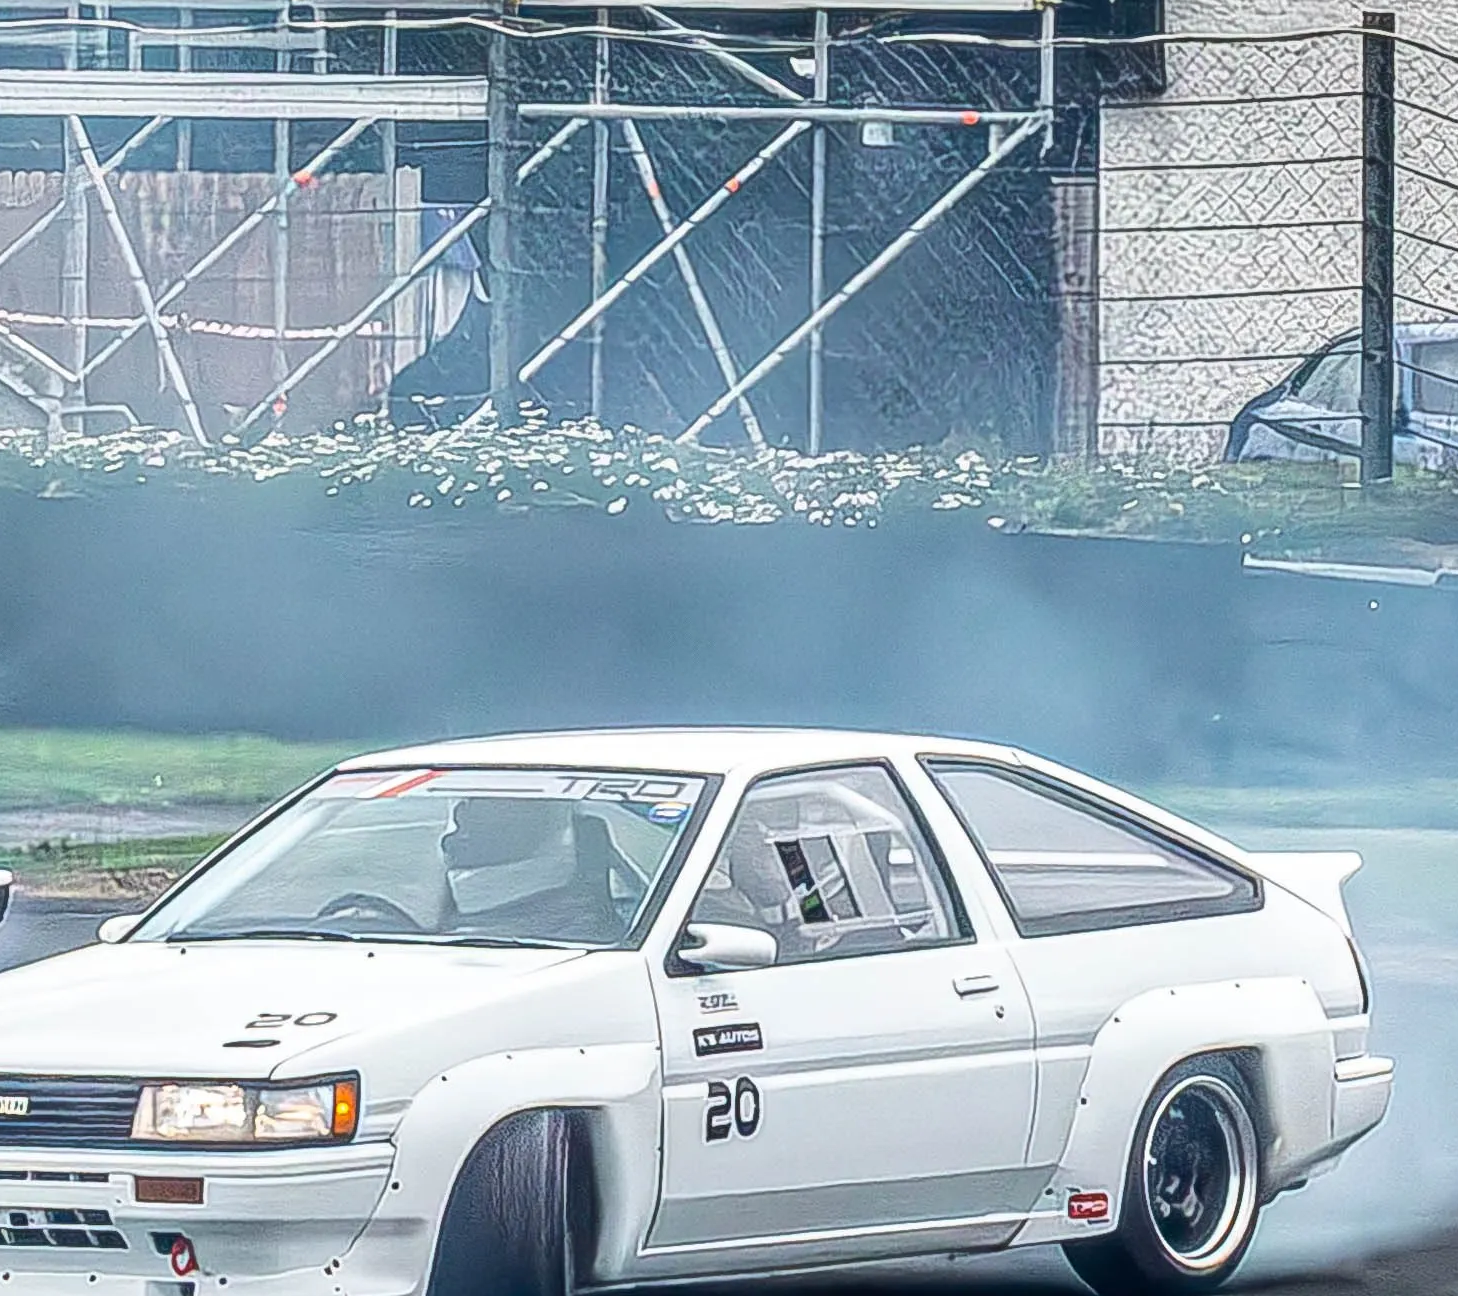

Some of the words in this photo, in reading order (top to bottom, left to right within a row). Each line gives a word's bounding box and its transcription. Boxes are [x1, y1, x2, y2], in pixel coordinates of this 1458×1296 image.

[556, 775, 688, 800] TRD
[244, 1011, 338, 1029] 20
[706, 1077, 760, 1142] 20
